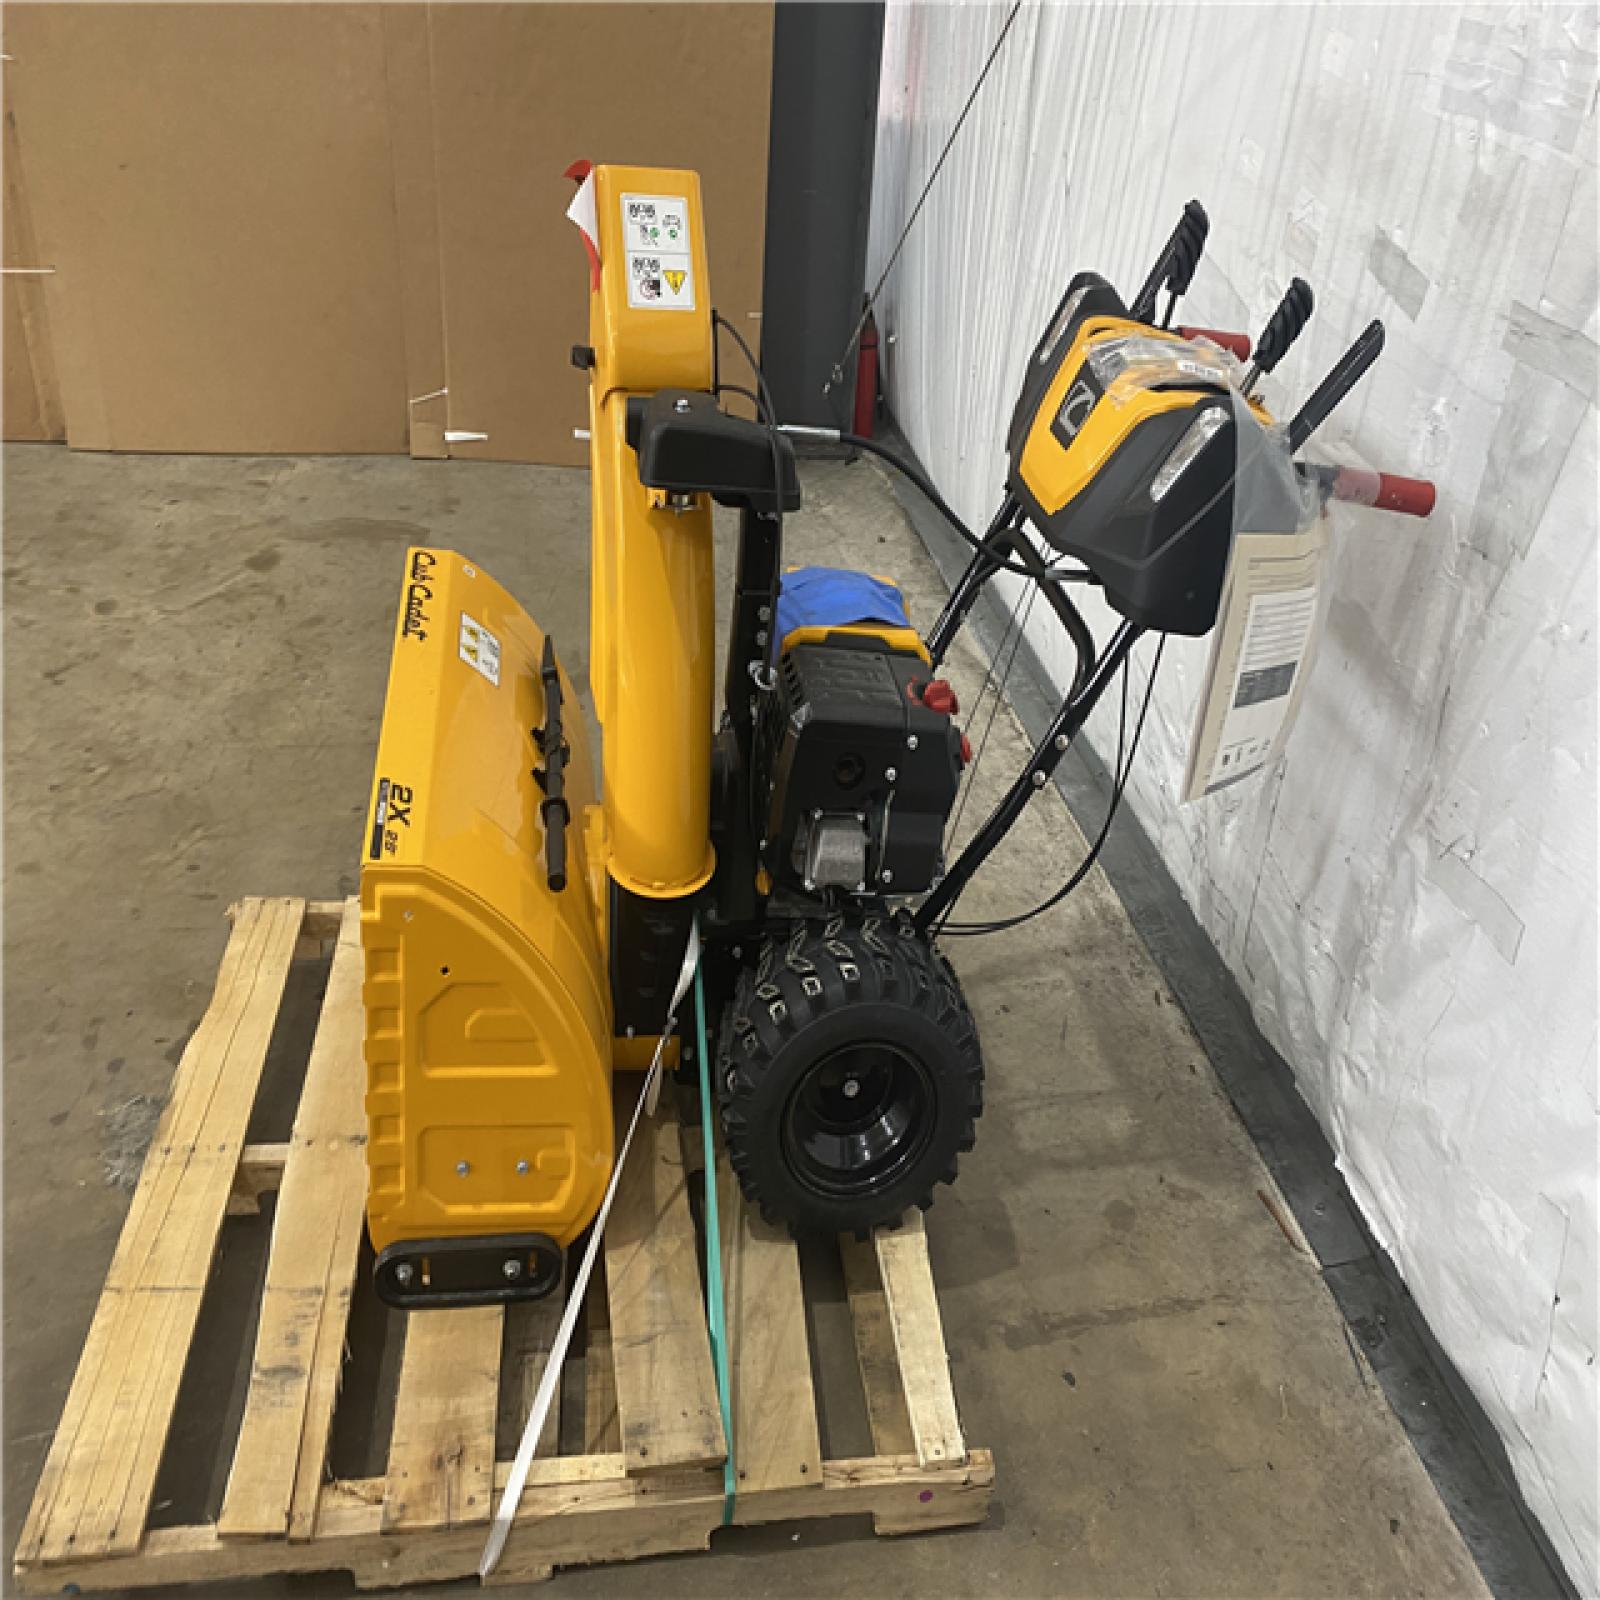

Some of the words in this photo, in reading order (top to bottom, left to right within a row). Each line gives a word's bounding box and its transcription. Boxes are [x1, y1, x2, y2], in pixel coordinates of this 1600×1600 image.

[411, 551, 435, 581] Cub
[402, 584, 432, 641] Cadet
[388, 784, 412, 828] 2X
